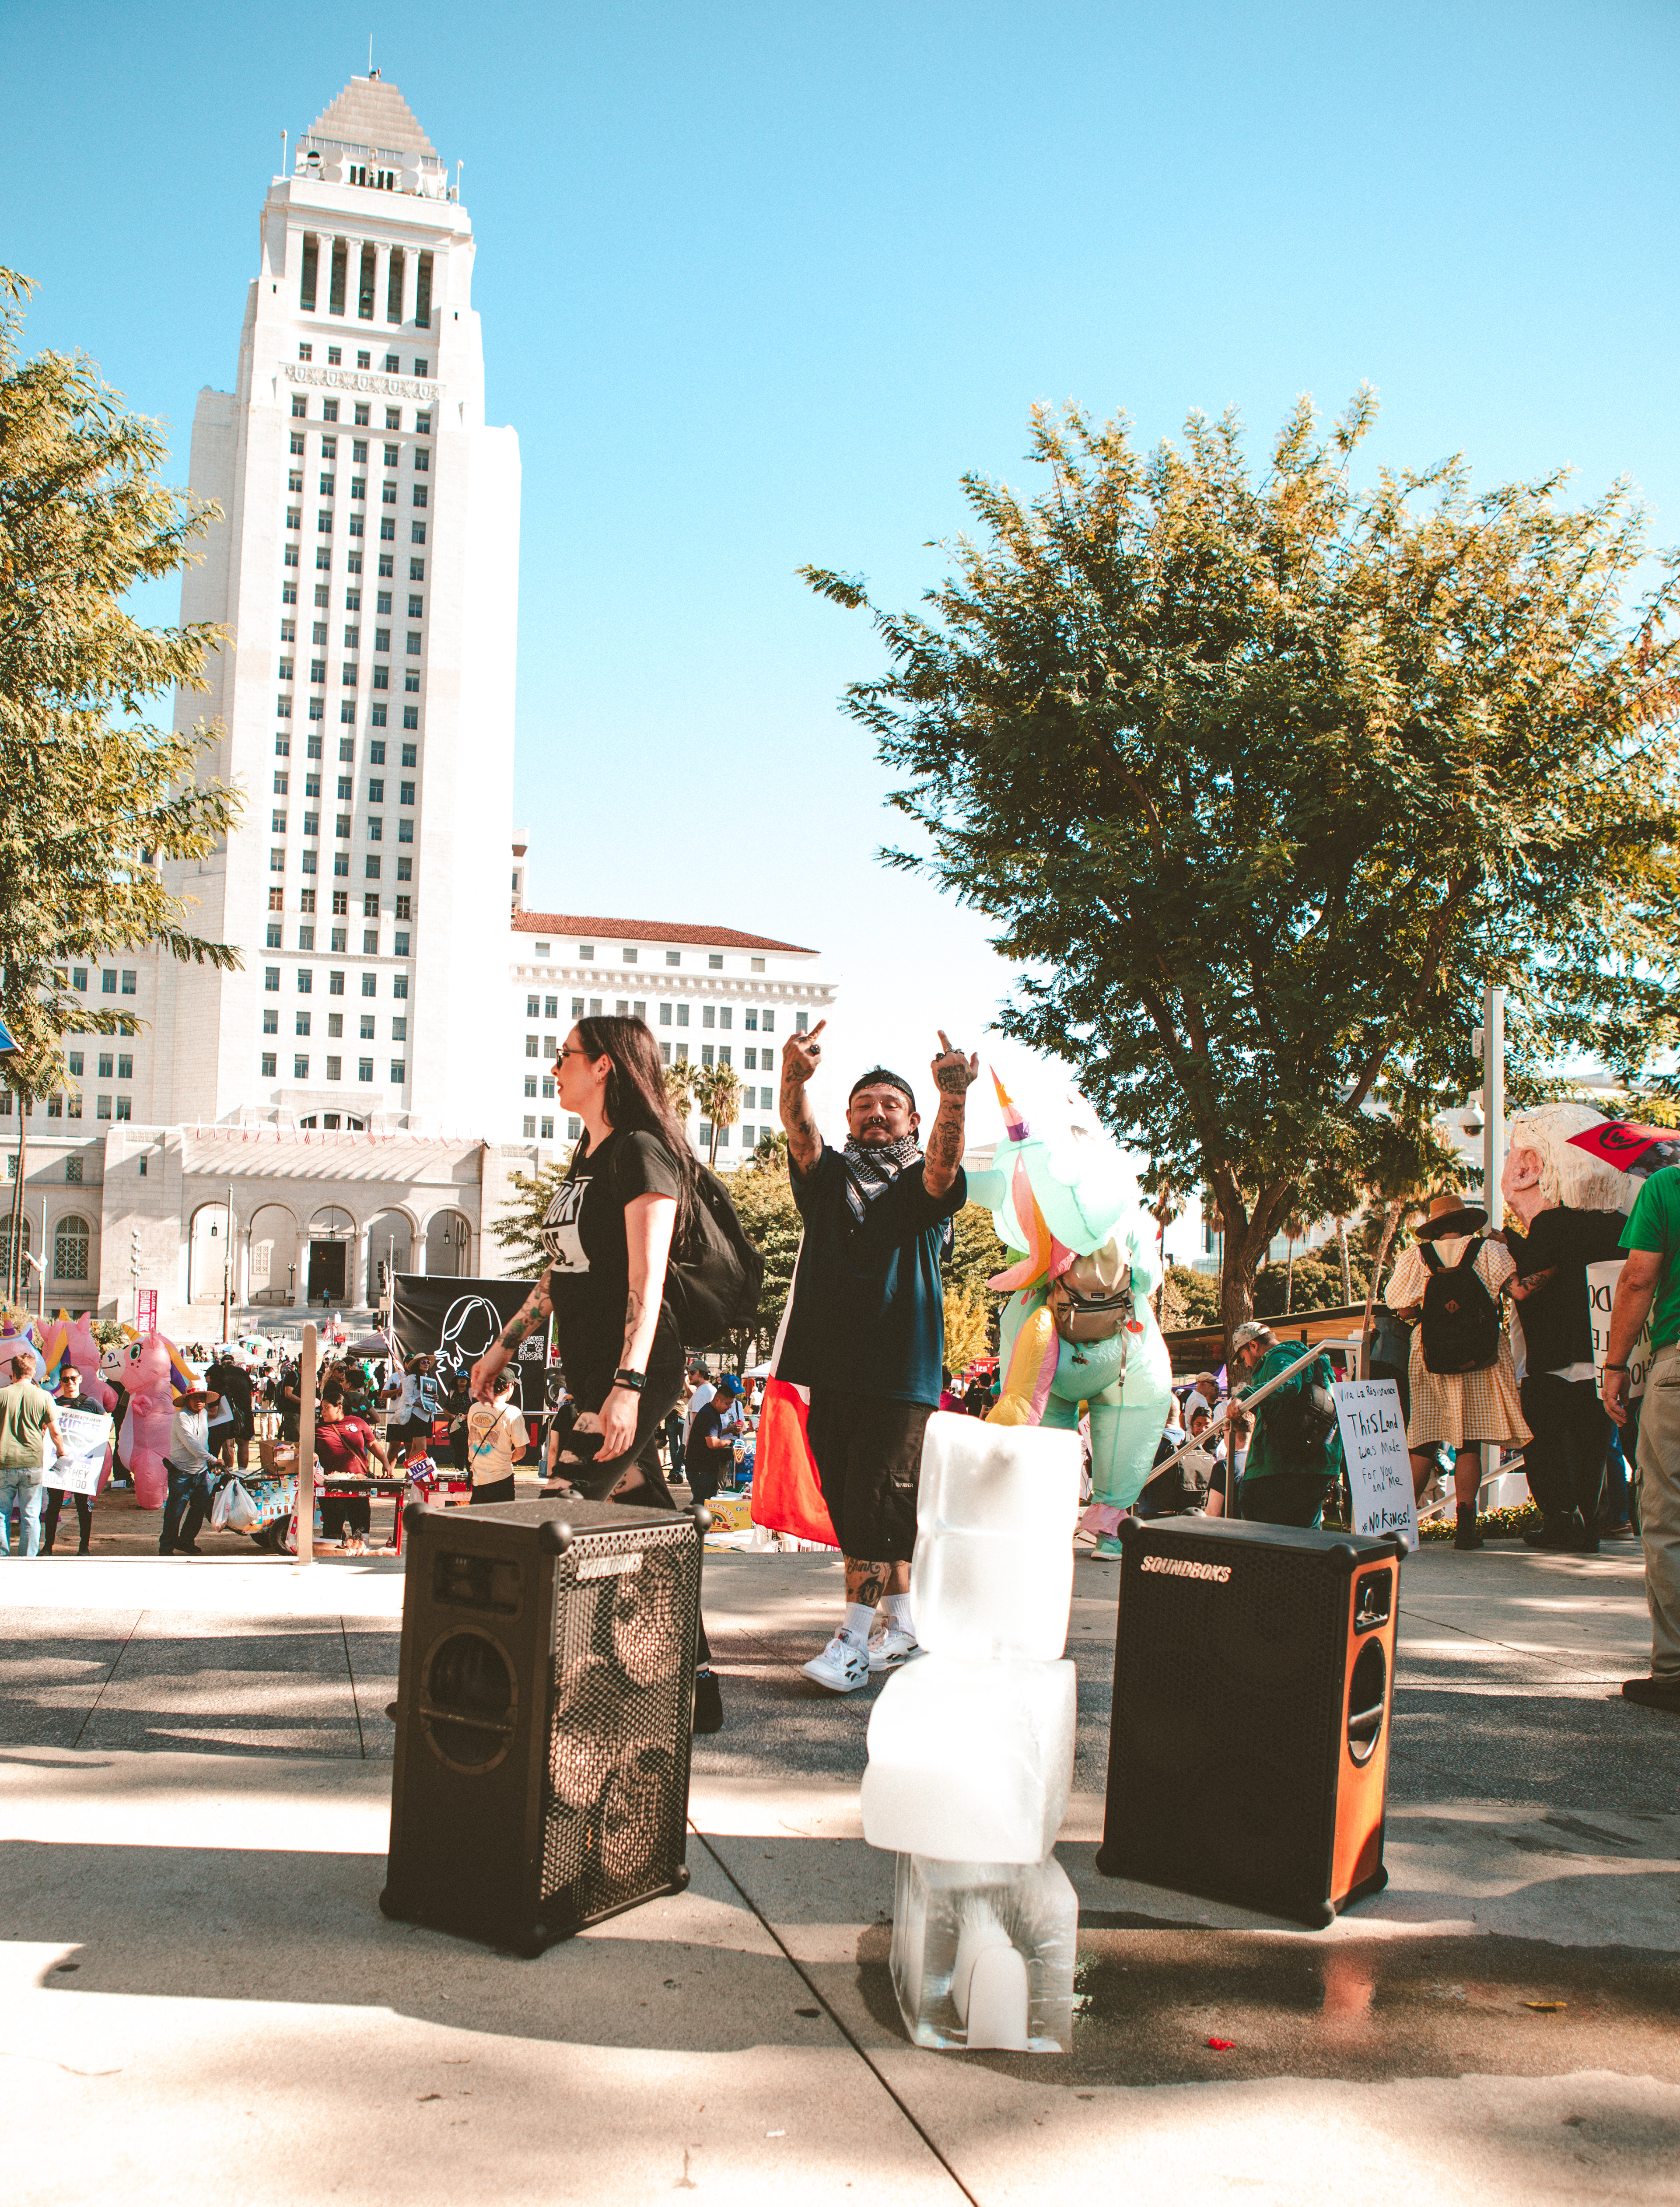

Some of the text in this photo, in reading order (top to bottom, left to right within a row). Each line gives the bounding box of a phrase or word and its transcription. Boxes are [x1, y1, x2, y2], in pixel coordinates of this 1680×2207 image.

[542, 1181, 589, 1225] UCK
[139, 1290, 150, 1332] GRAND PARK
[976, 1363, 990, 1372] les'
[1338, 1388, 1354, 1402] Viva
[1356, 1388, 1365, 1398] La
[1381, 1439, 1401, 1455] Made
[69, 1468, 89, 1479] THEY
[410, 1459, 429, 1475] NOT
[45, 1474, 87, 1489] SUCK TOO
[1372, 1482, 1385, 1492] and
[575, 1553, 644, 1581] SOUNDBOKS
[1141, 1555, 1232, 1583] SOUNDBOKS
